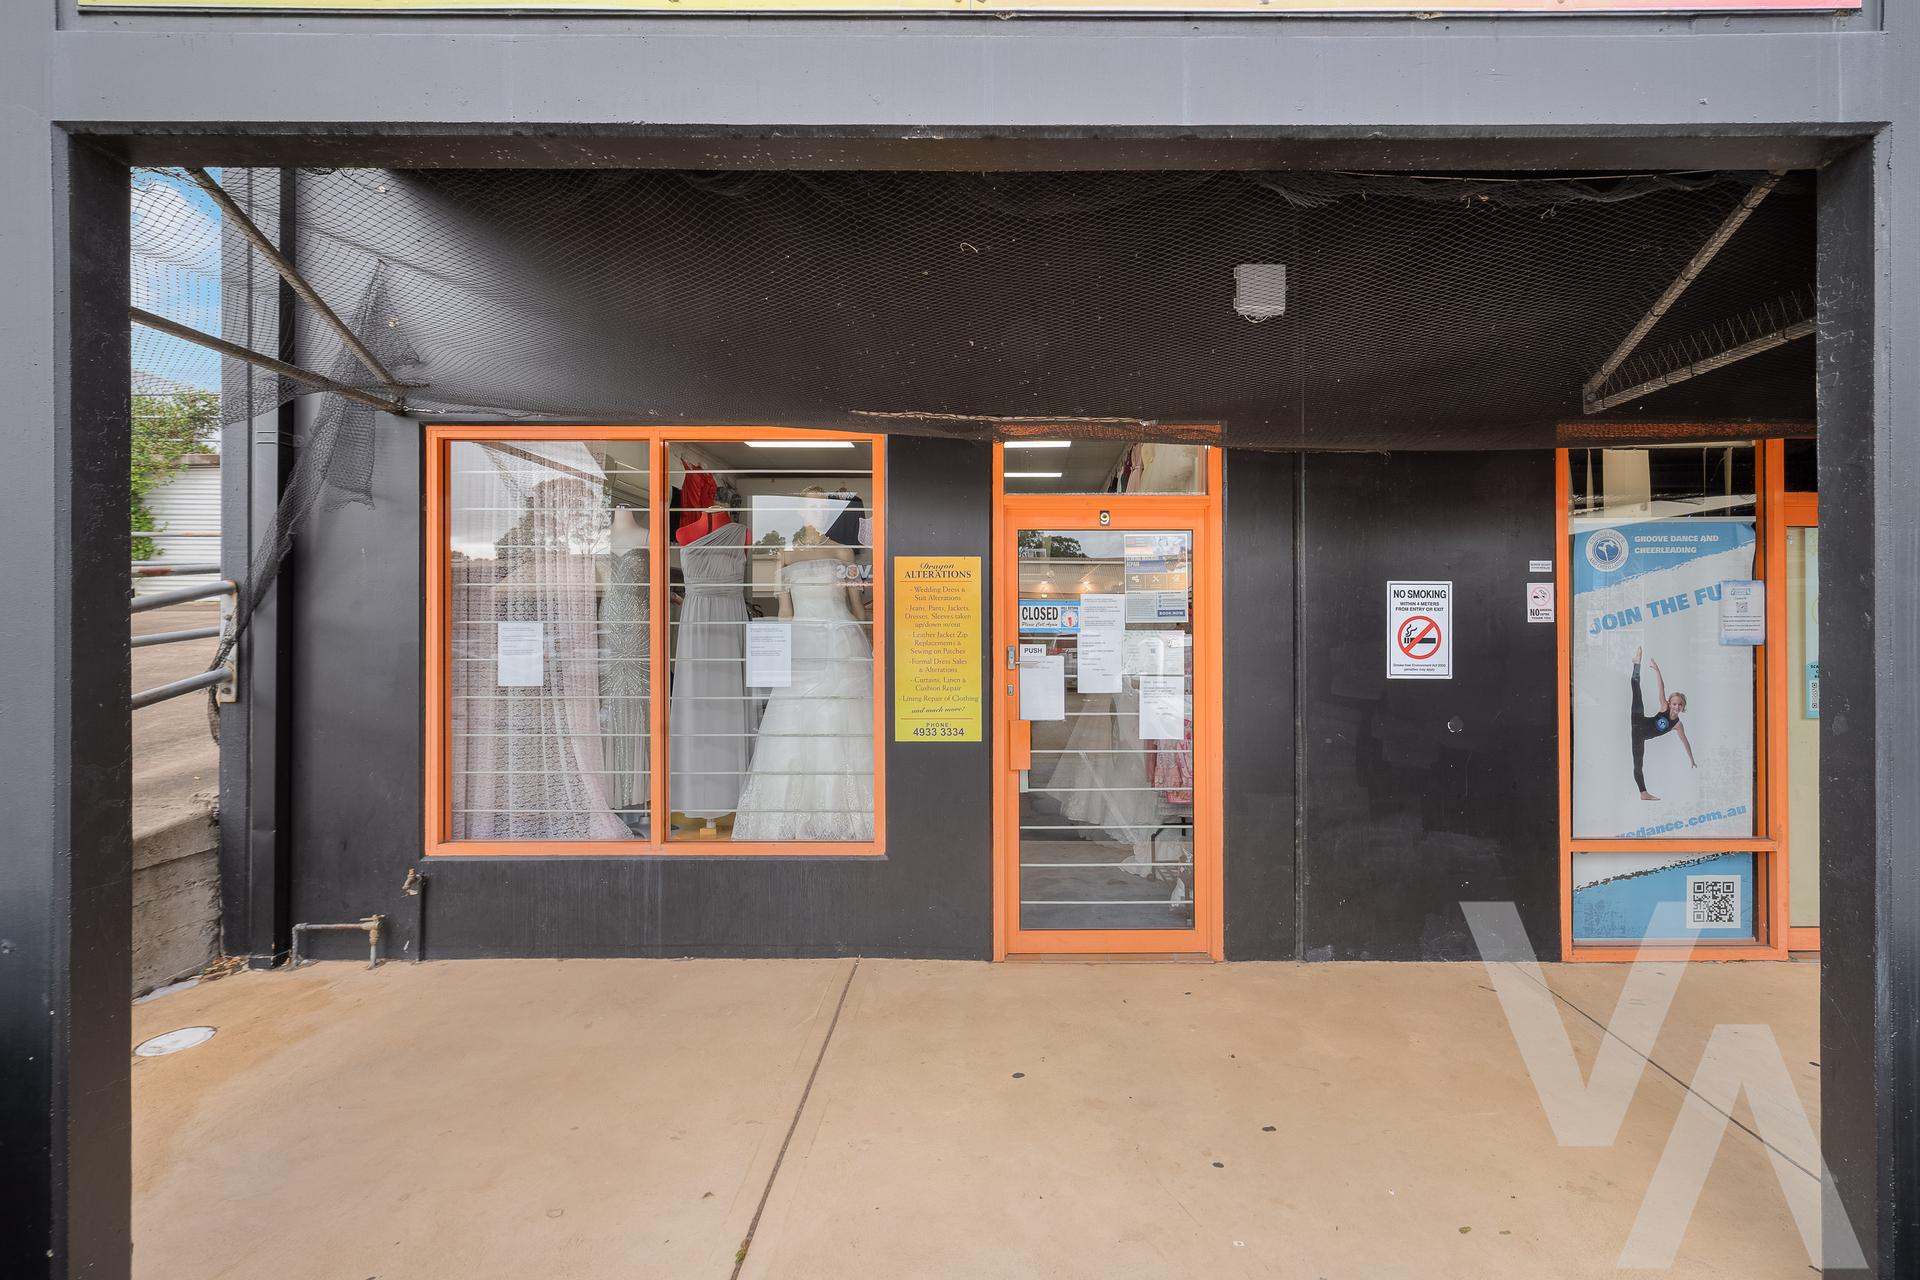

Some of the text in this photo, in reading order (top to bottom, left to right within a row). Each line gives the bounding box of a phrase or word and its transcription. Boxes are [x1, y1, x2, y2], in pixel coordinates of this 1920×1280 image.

[1100, 512, 1110, 524] 9
[920, 562, 955, 572] Dragon
[904, 571, 972, 579] ALTERATIONS
[1393, 589, 1447, 599] NO SMOKING
[1022, 606, 1058, 620] CLOSED
[1589, 584, 1723, 636] JOIN THE FU
[915, 621, 942, 629] up/down
[957, 631, 968, 639] Zip
[942, 685, 961, 693] Repair
[923, 695, 943, 703] Repair
[951, 695, 979, 703] Clothing
[913, 727, 965, 737] 4933 3334
